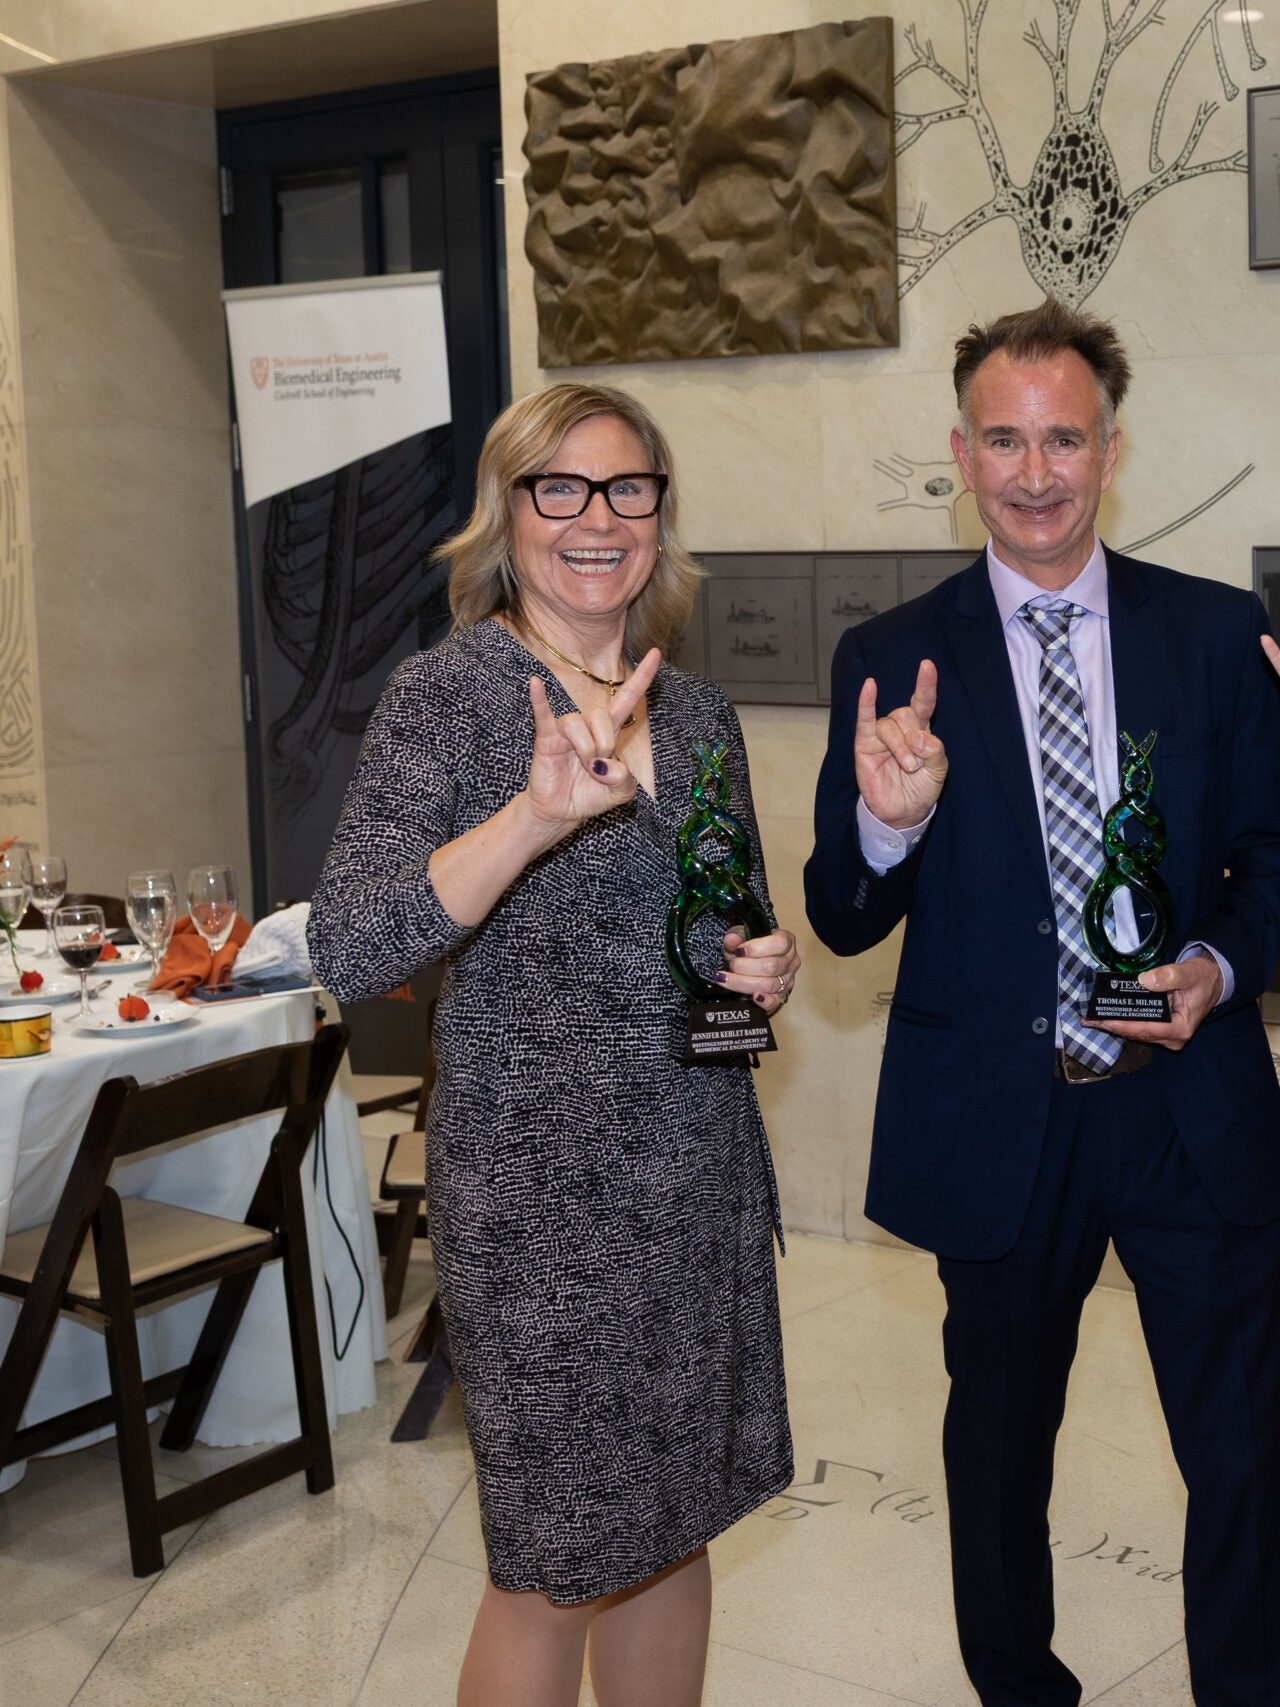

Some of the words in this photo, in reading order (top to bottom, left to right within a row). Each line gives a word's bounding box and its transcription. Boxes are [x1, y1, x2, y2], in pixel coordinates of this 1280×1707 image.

[274, 367, 334, 386] Biomedical
[336, 364, 402, 386] Engineering
[1096, 997, 1126, 1005] THOMAS
[1135, 999, 1163, 1007] MILNER
[715, 1010, 750, 1020] TEXAS
[692, 1032, 719, 1040] JENNIFER
[745, 1028, 767, 1036] BARTON
